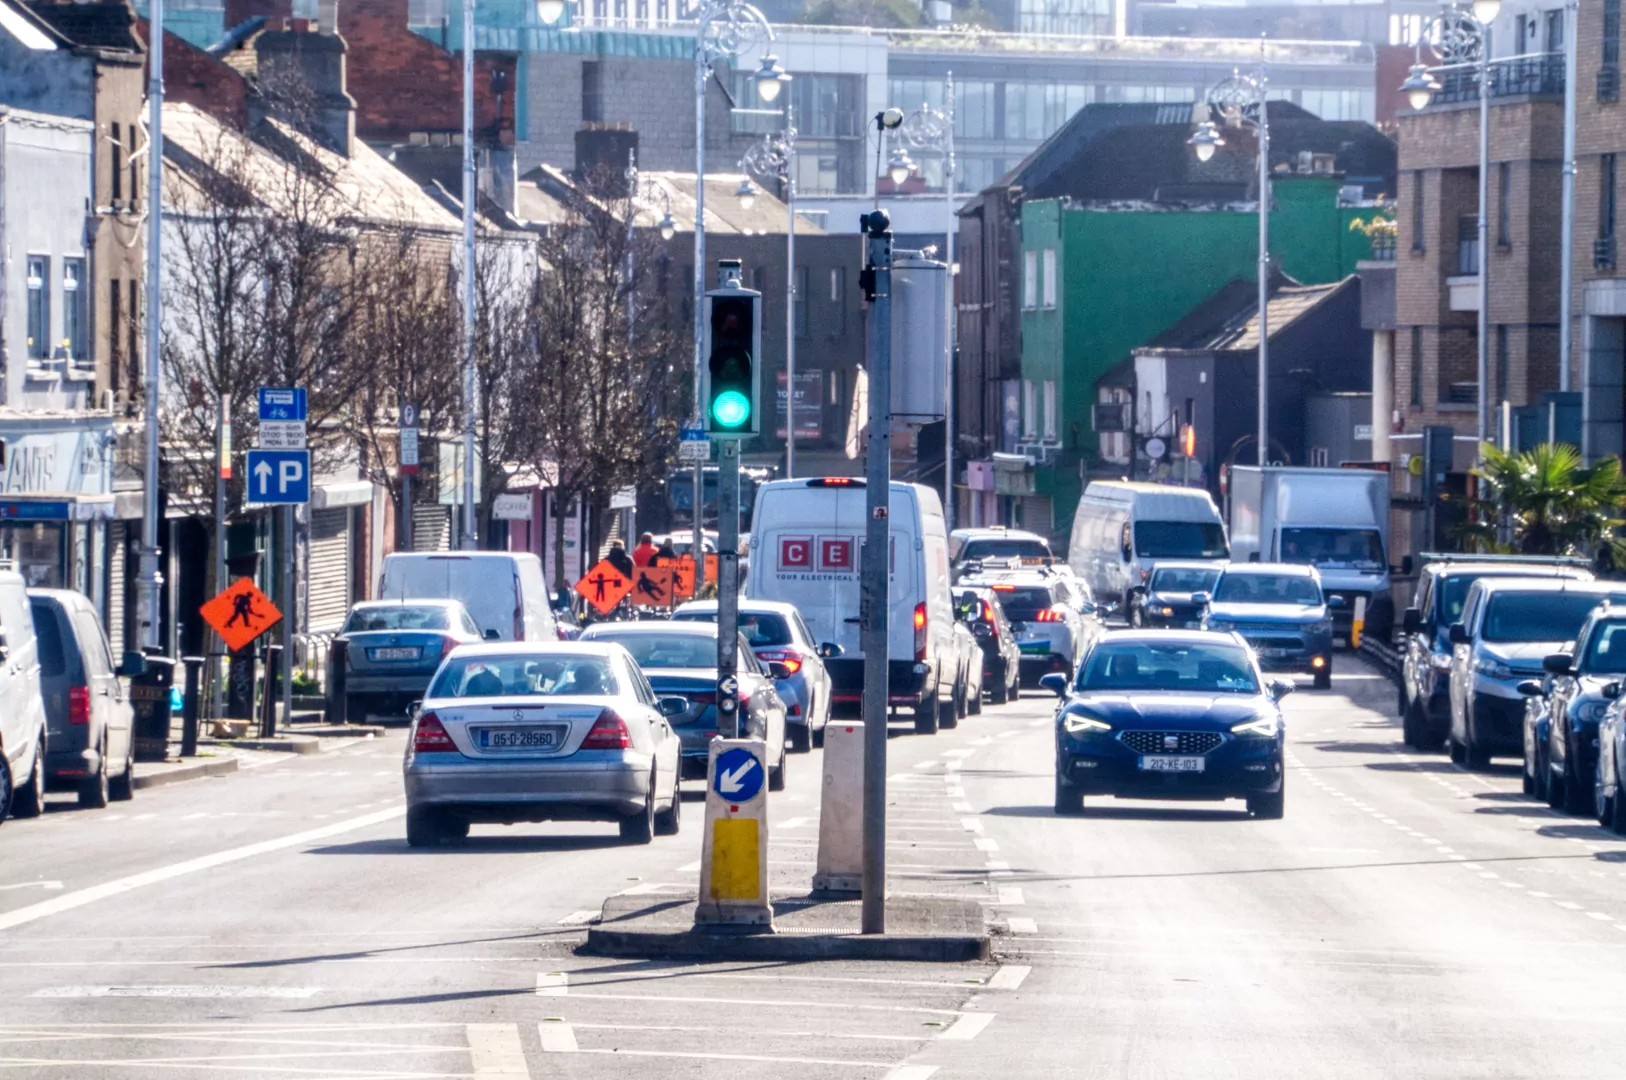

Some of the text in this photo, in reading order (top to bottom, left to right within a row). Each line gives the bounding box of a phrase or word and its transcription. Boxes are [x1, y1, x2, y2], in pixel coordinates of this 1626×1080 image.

[279, 461, 303, 493] P
[494, 733, 552, 745] 05-D-28560
[1151, 758, 1197, 769] 212-KE-103
